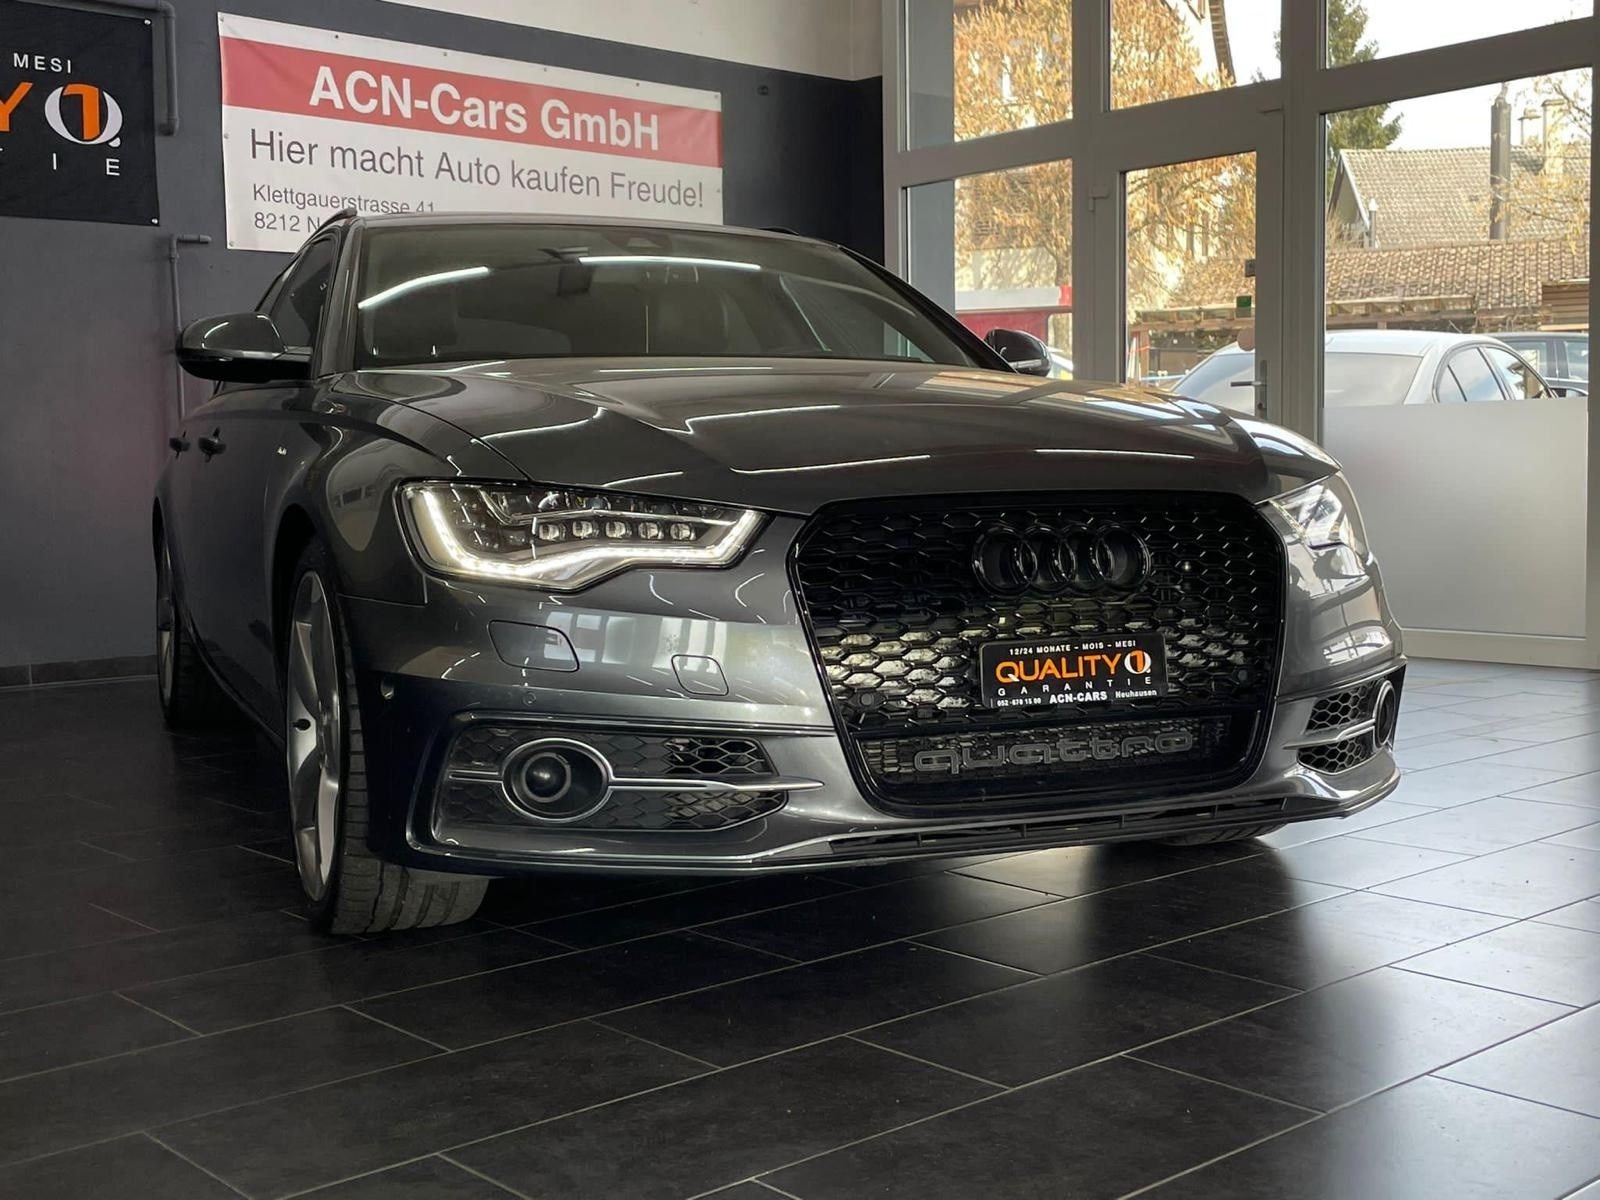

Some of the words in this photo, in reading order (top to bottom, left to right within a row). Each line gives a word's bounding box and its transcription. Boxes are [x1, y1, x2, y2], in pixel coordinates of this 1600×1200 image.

[13, 53, 72, 74] MESI
[309, 65, 528, 134] ACN-Cars
[540, 98, 659, 151] GmbH
[250, 128, 319, 166] Hier
[330, 146, 425, 178] macht
[434, 152, 501, 187] Auto
[511, 160, 601, 198] kaufen
[610, 172, 703, 208] Freude!
[252, 183, 410, 213] Klettgauerstrasse
[416, 201, 435, 213] 41
[254, 212, 301, 232] 8212
[1010, 648, 1034, 656] 12/24
[1036, 644, 1071, 654] MONATE
[1082, 641, 1104, 650] MOIS
[1115, 640, 1136, 648] MESI
[995, 653, 1122, 684] QUALITY
[997, 676, 1152, 697] GARANTIE
[1049, 690, 1108, 705] ACN-CARS
[1115, 689, 1158, 699] Neuhausen
[913, 730, 1193, 775] quattro
